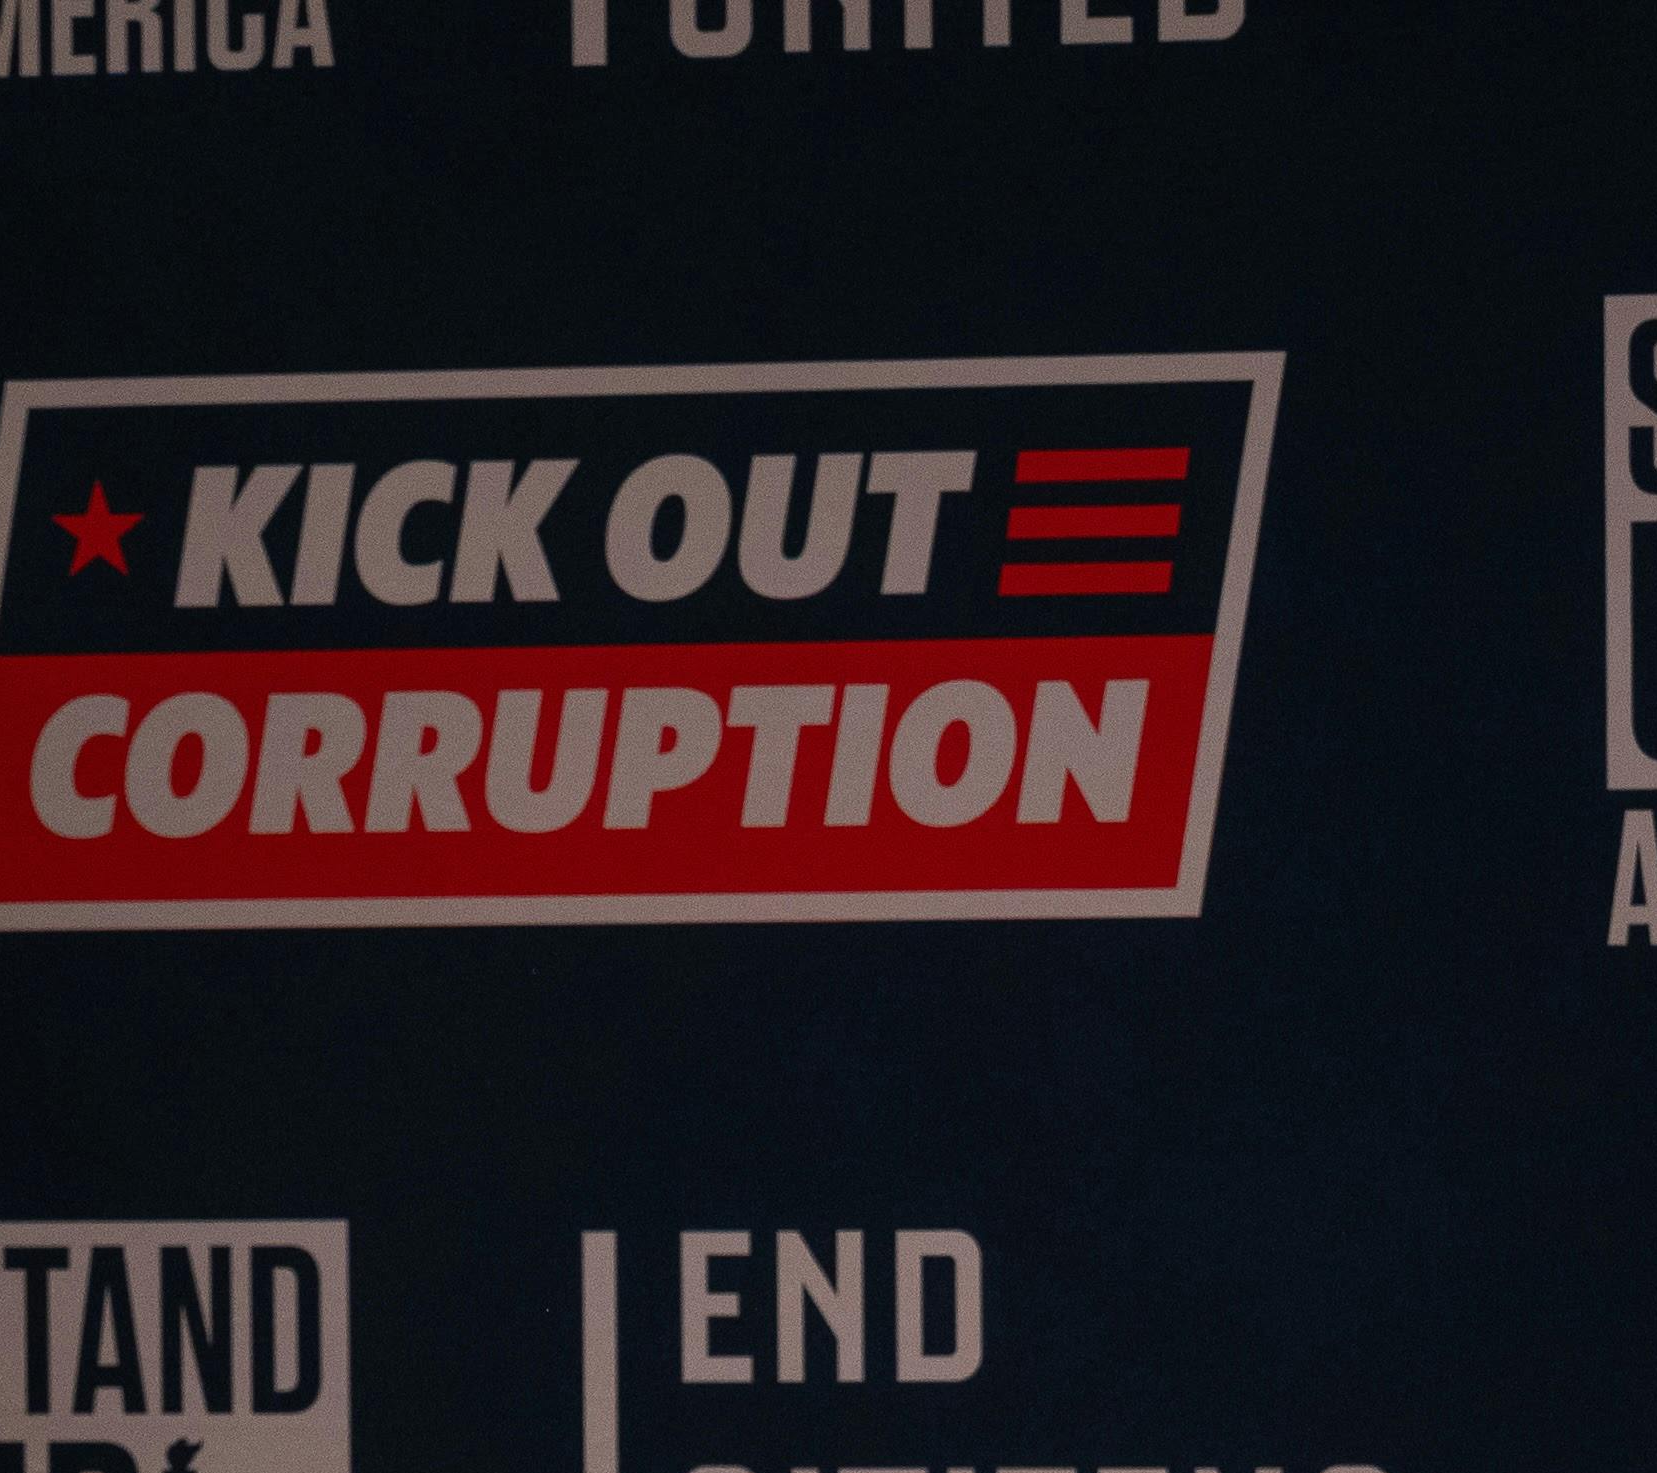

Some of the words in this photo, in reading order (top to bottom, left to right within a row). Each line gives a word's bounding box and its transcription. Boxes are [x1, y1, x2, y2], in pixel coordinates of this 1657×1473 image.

[174, 459, 579, 607] KICK
[605, 450, 977, 602] OUT
[30, 679, 1150, 839] CORRUPTION
[679, 1229, 984, 1384] END
